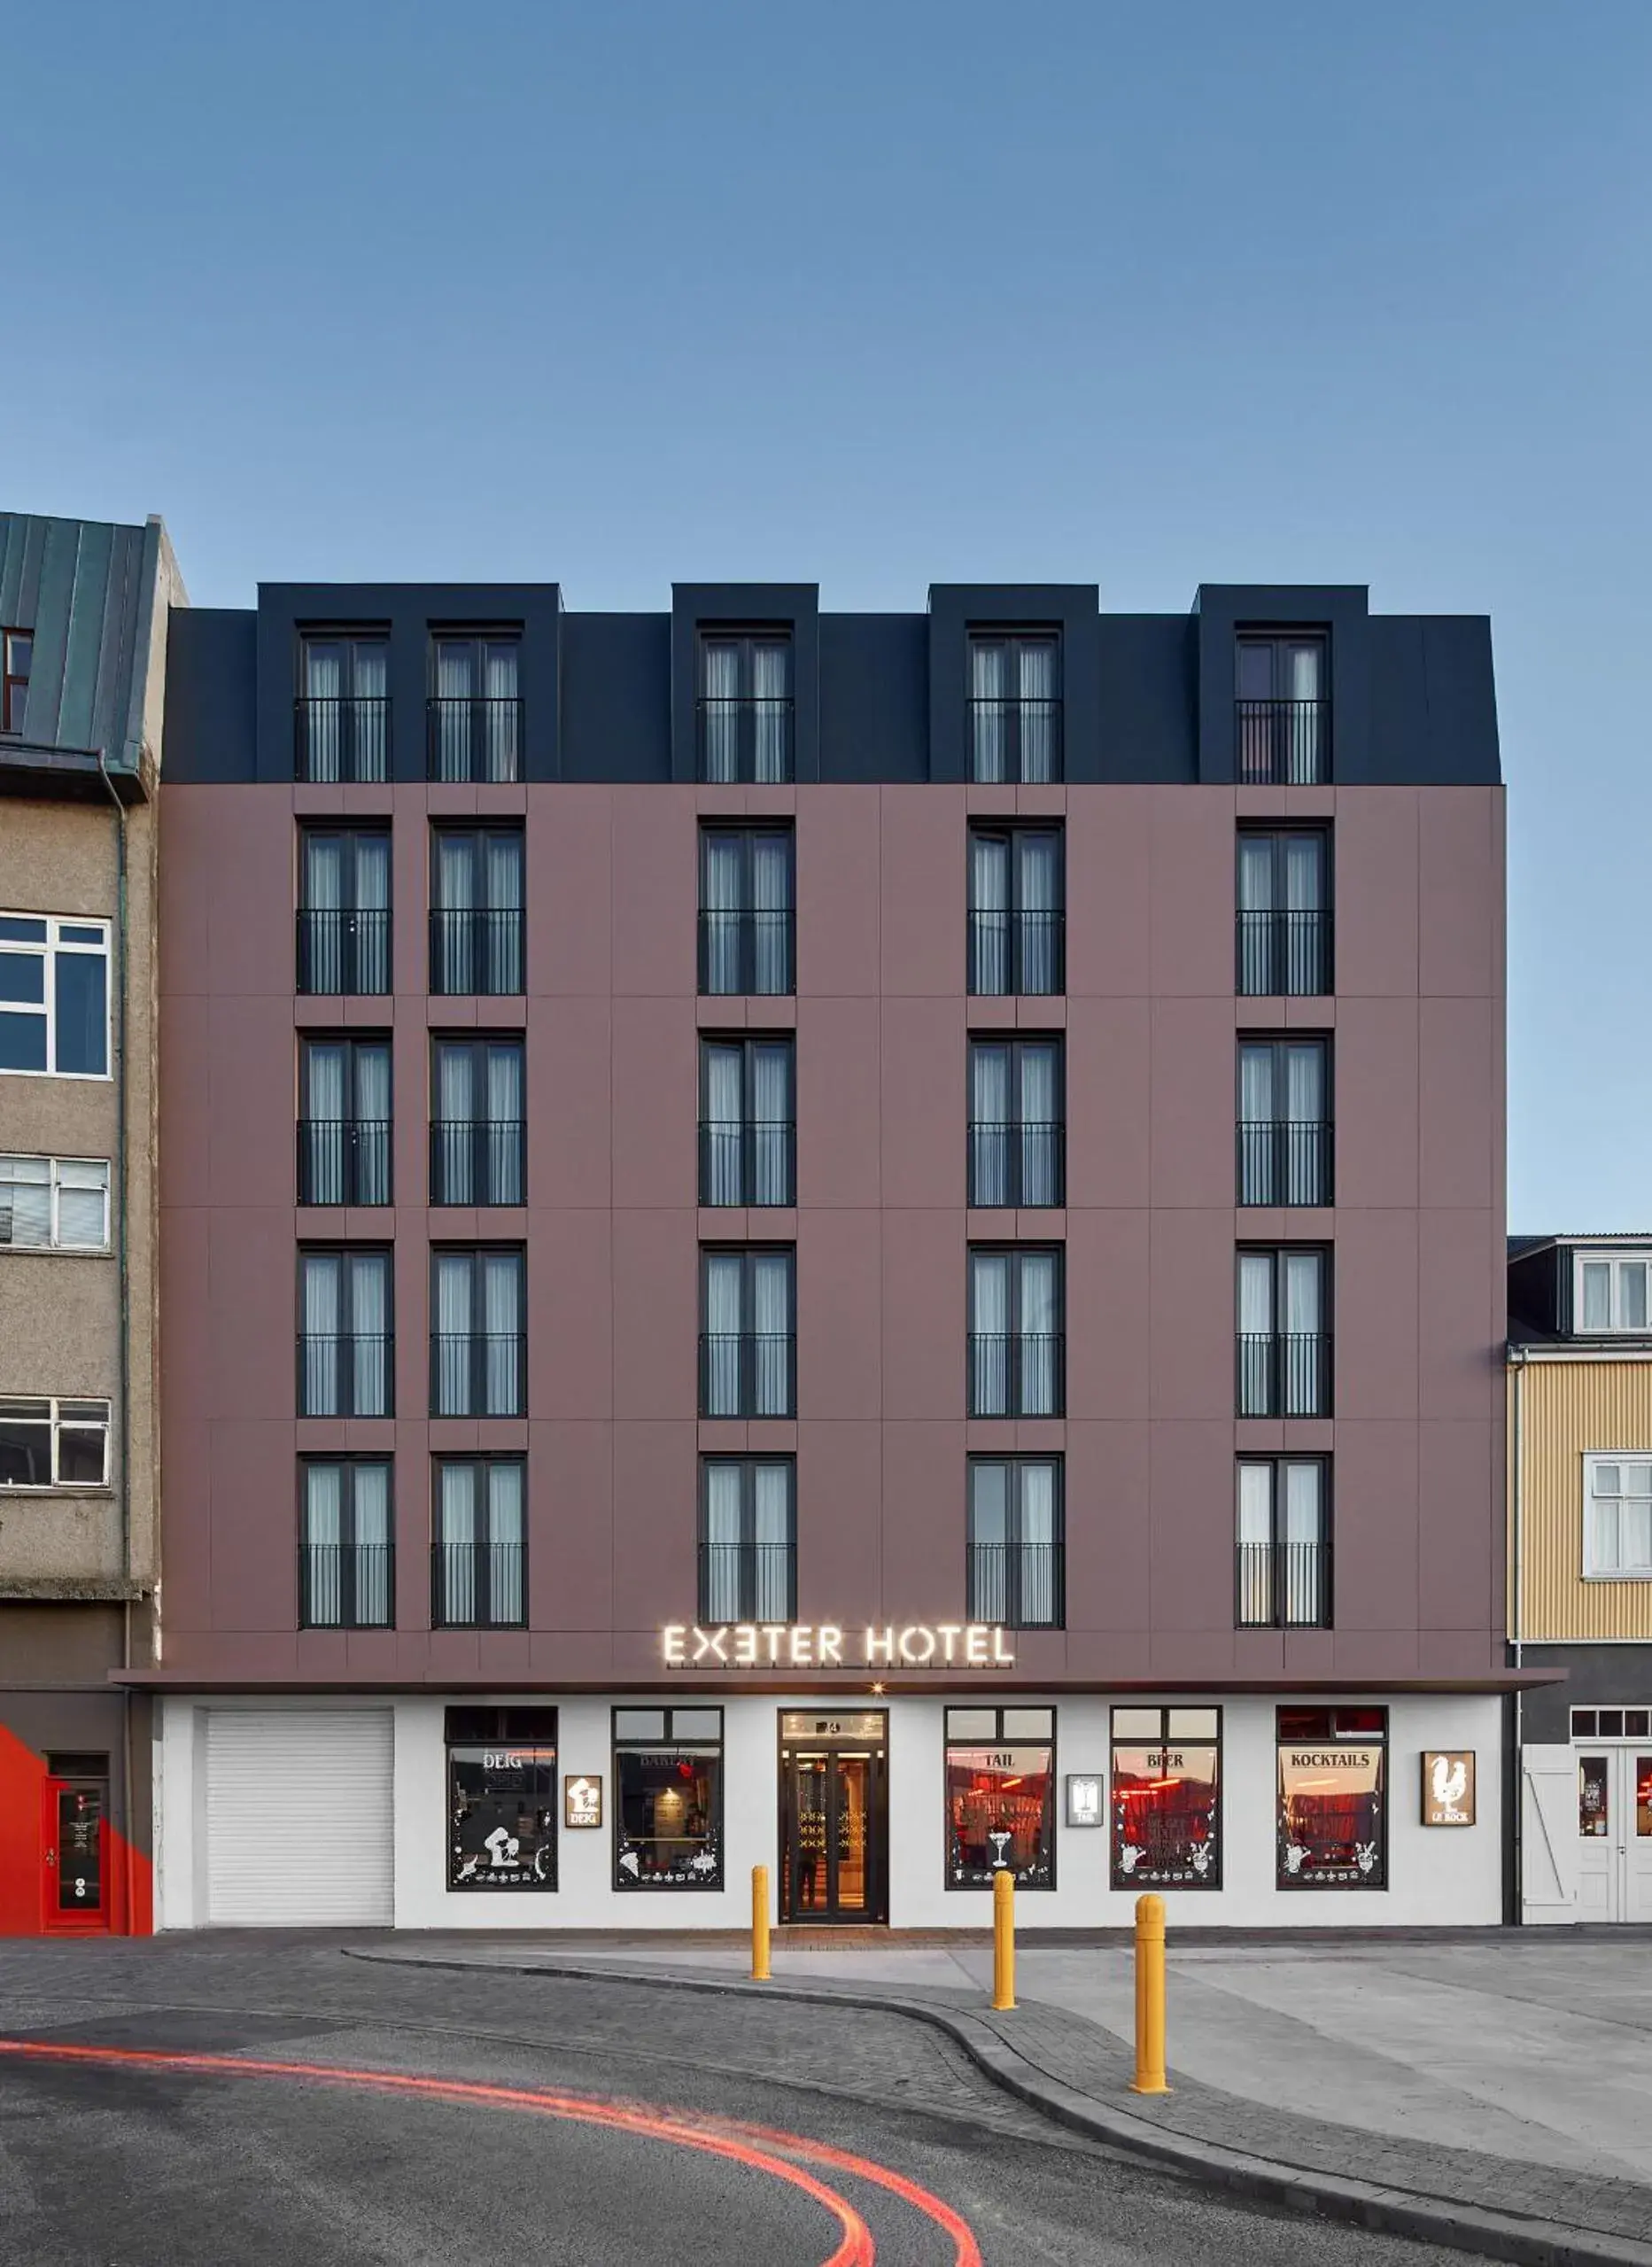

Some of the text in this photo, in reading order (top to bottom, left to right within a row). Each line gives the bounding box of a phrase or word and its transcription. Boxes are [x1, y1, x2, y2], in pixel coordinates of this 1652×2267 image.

[664, 1626, 1014, 1661] EXETER HOTEL
[483, 1754, 523, 1769] DEIG
[984, 1754, 1015, 1767] TAIL
[1147, 1754, 1184, 1768] BEER
[1291, 1754, 1369, 1766] KOCKTAILS
